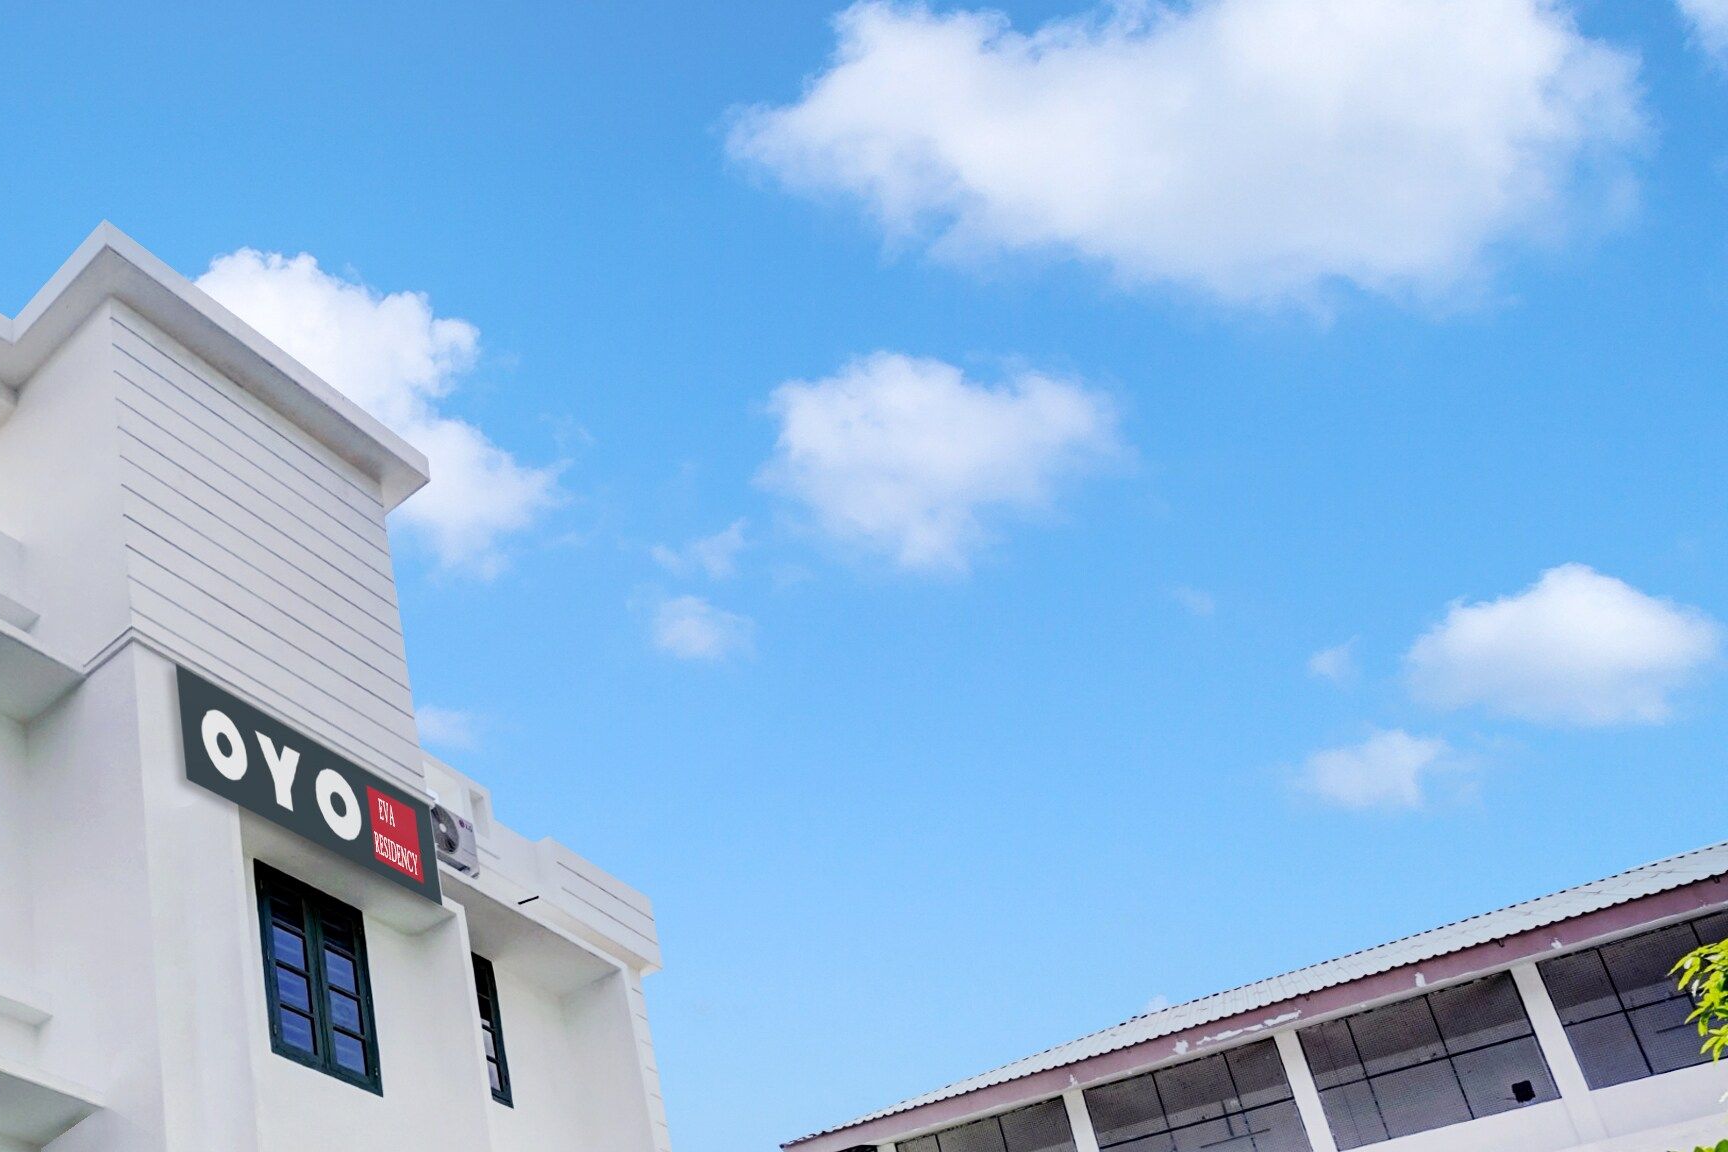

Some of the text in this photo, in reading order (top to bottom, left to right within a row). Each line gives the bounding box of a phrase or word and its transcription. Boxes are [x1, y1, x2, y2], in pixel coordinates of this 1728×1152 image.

[201, 709, 362, 841] OYO
[377, 797, 396, 828] EVA
[373, 830, 419, 876] RESIDENCY
